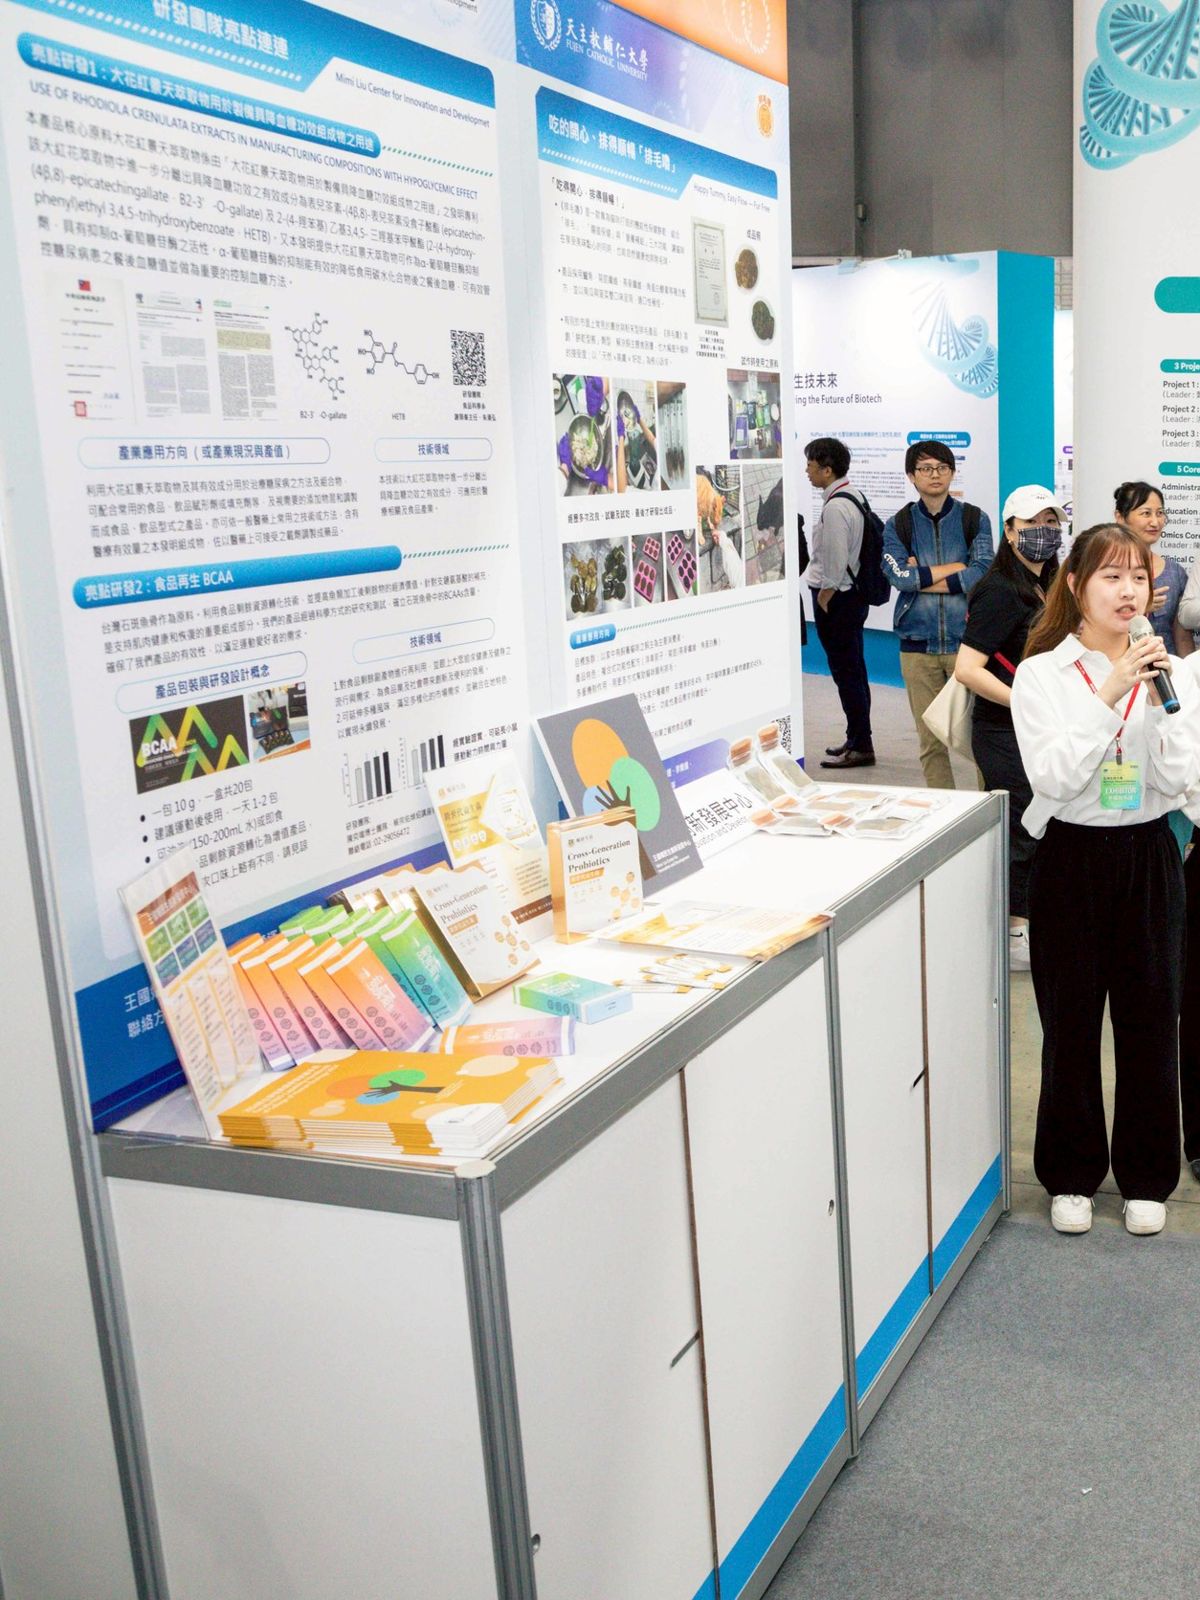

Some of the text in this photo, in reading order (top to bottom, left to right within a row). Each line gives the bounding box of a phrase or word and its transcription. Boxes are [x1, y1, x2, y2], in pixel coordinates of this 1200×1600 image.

[566, 18, 649, 71] 天主教輔仁大學
[617, 61, 648, 81] UNIVERSITY
[336, 72, 354, 88] Mimi
[356, 78, 367, 91] Liu
[368, 82, 391, 99] Center
[392, 89, 402, 101] for
[403, 93, 438, 113] Innovation
[439, 103, 451, 116] and
[30, 80, 478, 200] USE OF RHODIOLA CRENULATA EXTRACTS IN MANUFACTURING COMPOSITIONS WITH HYPOGLYCEMIC EFFECT
[1174, 362, 1180, 371] 3
[794, 373, 838, 389] 生技未來
[1162, 380, 1190, 389] Project
[808, 395, 819, 404] the
[821, 394, 844, 404] Future
[845, 394, 854, 404] of
[854, 394, 882, 404] Biotech
[1162, 405, 1190, 414] Project
[1162, 430, 1190, 438] Project
[1161, 532, 1183, 540] Omics
[203, 570, 234, 586] BCAA
[142, 737, 178, 759] BCAA
[174, 798, 188, 813] 10
[252, 797, 269, 813] 1-2
[568, 840, 631, 861] Cross-Generation
[568, 857, 610, 873] Probiotics
[433, 882, 489, 912] Cross-Generation
[440, 902, 478, 925] Probiotics
